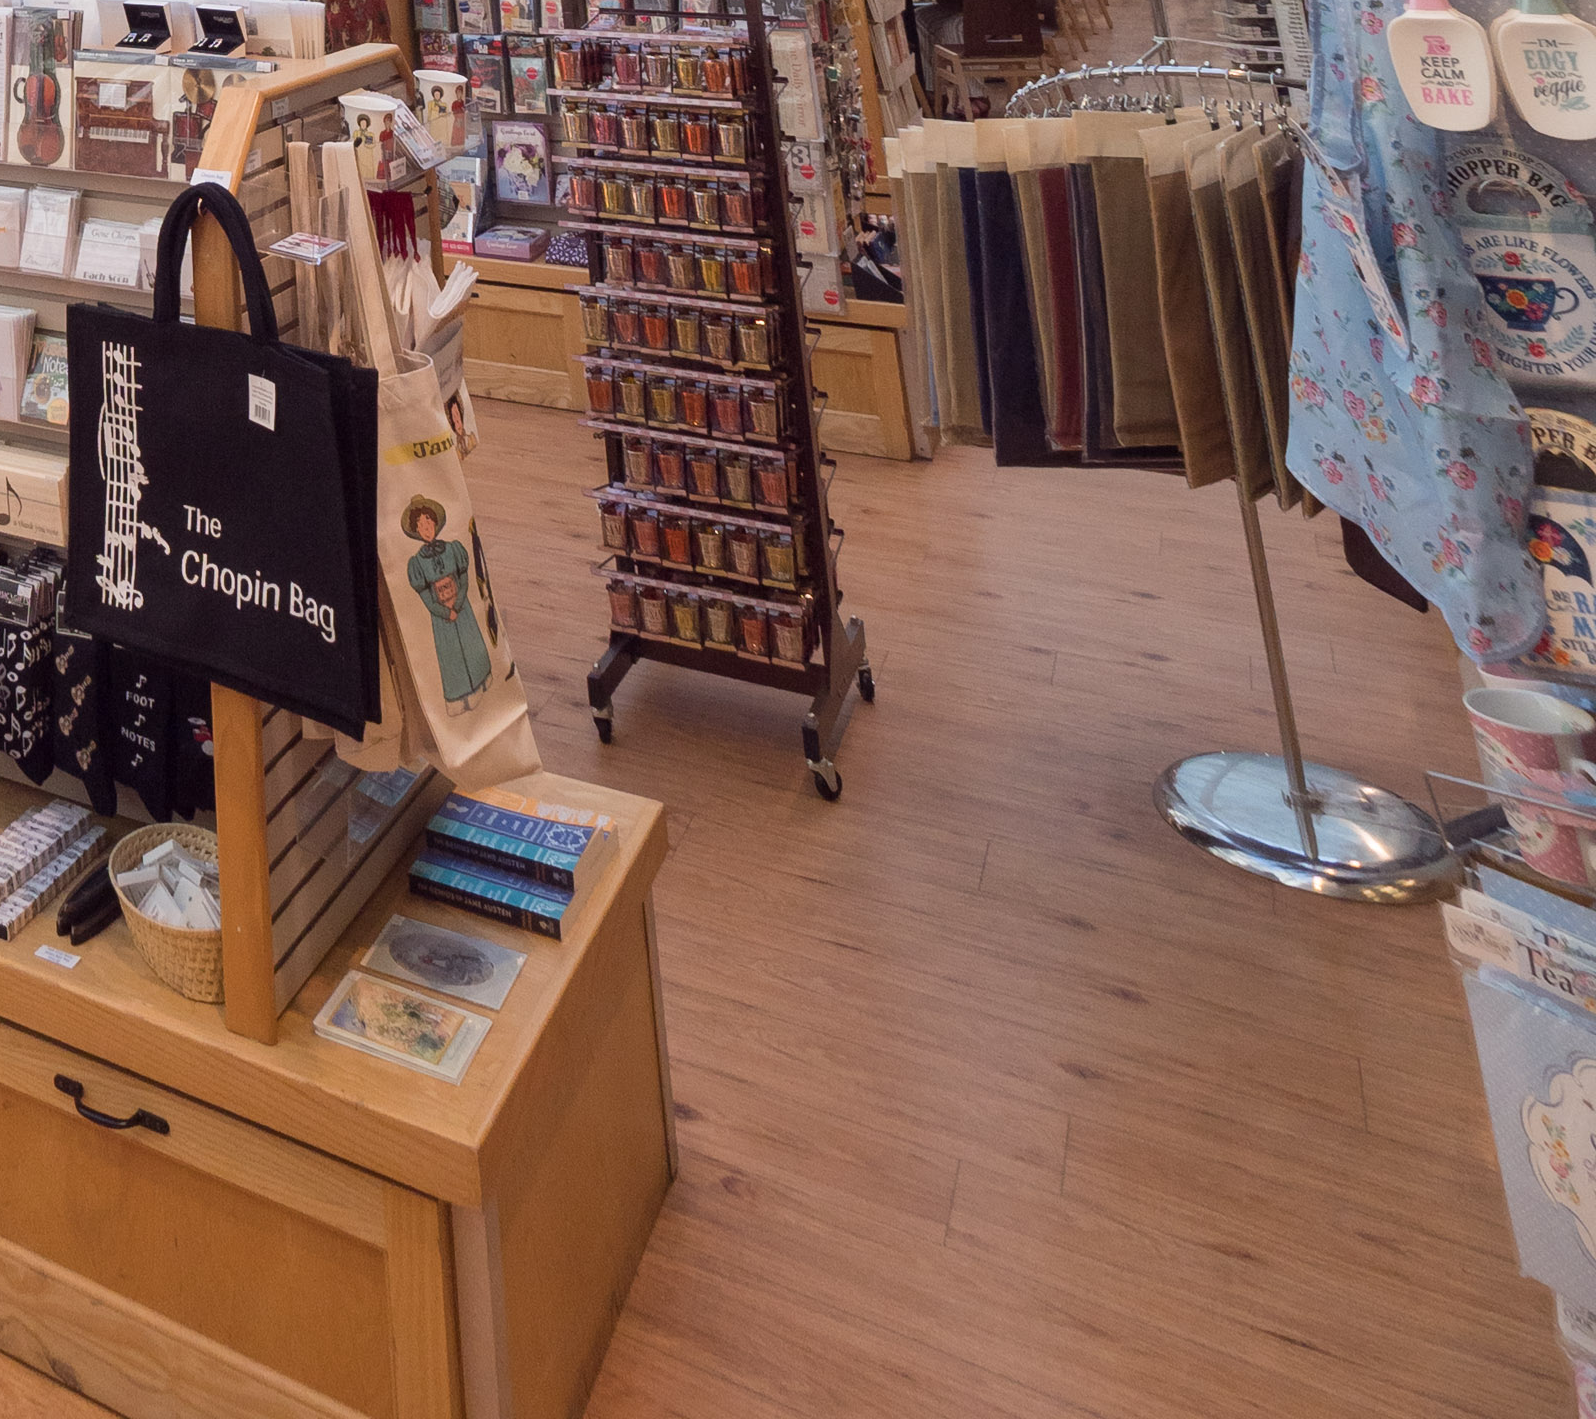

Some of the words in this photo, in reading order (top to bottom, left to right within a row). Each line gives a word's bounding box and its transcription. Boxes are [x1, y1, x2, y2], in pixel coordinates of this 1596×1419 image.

[1420, 56, 1460, 67] KEEP
[1524, 49, 1578, 71] EDGY
[1421, 68, 1465, 80] CALM
[1421, 87, 1475, 106] BAKE
[1534, 79, 1584, 106] veggie
[1528, 170, 1568, 208] BAG
[1476, 235, 1500, 249] ARE
[1505, 235, 1539, 253] LIKE
[183, 504, 222, 538] The
[181, 550, 280, 611] Chopin
[289, 581, 336, 643] Bag
[125, 690, 155, 709] FOOT
[121, 726, 156, 752] NOTES
[484, 903, 512, 918] AUSTEN
[1514, 937, 1577, 997] Tea
